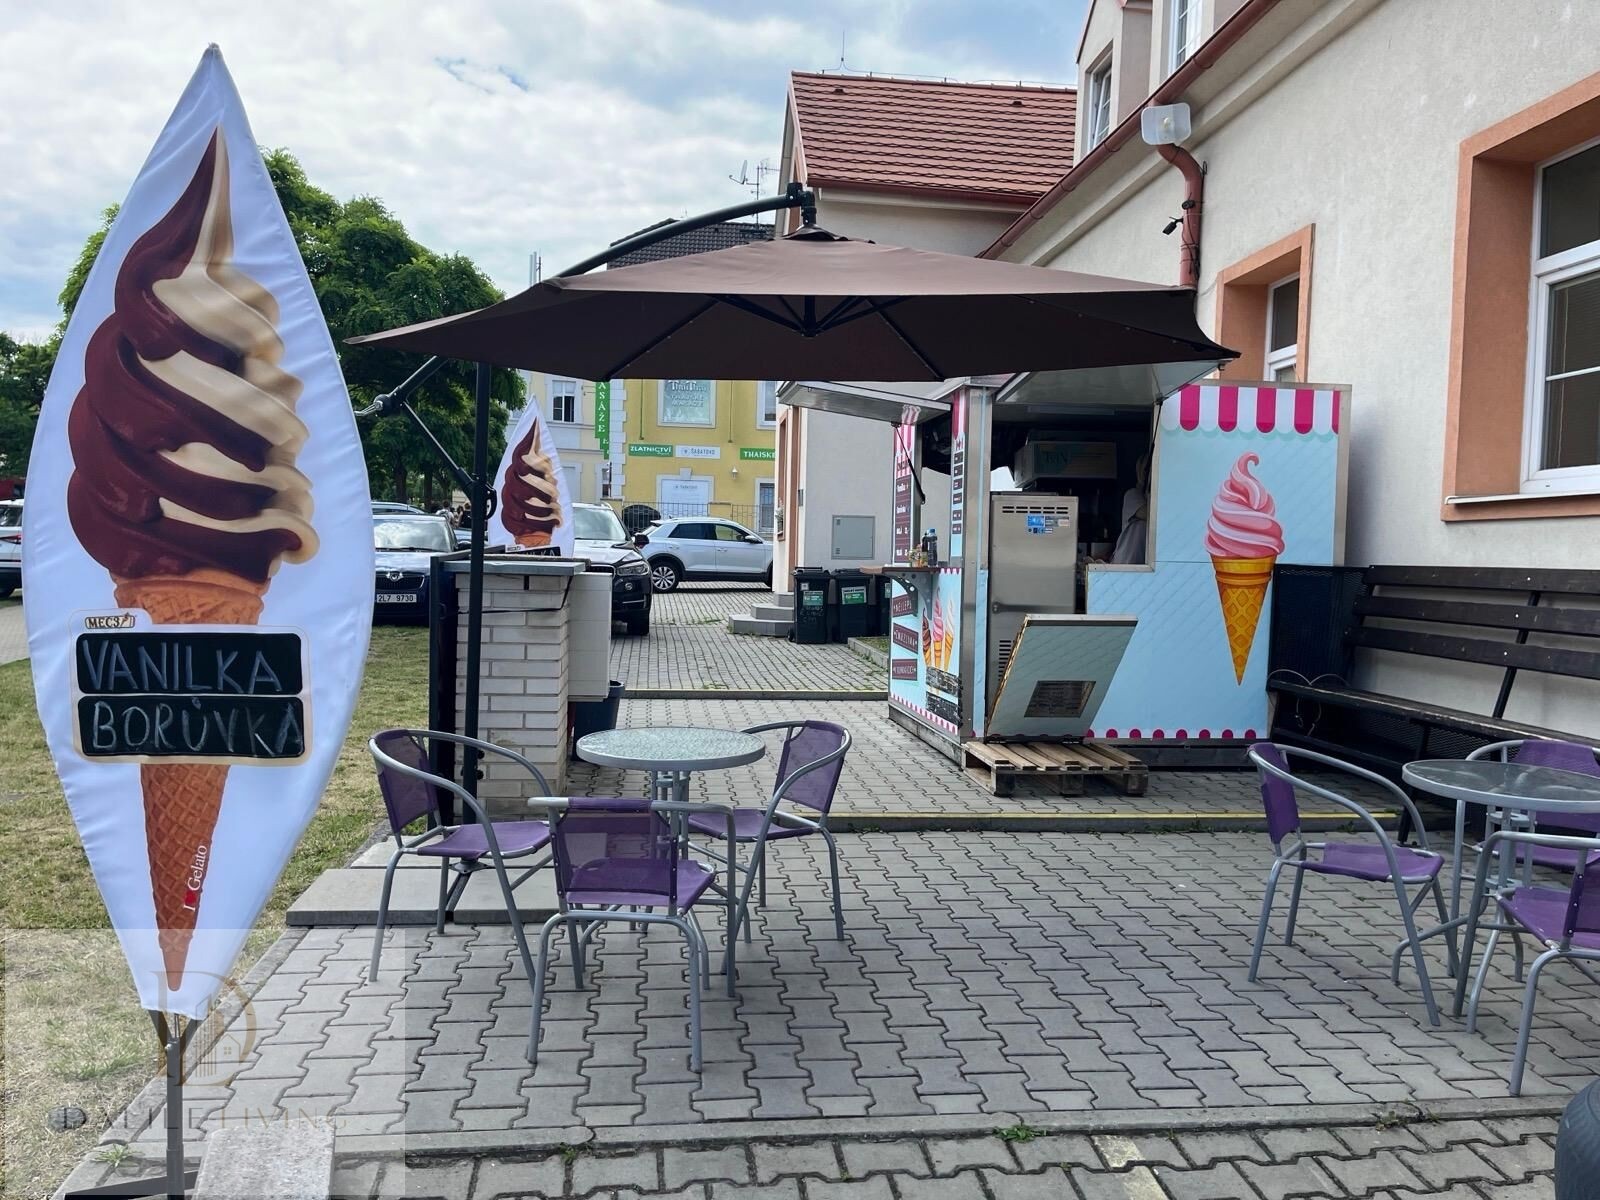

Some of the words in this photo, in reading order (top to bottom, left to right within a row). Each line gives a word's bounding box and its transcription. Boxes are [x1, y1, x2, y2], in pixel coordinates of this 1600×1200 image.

[88, 616, 120, 627] MEC3
[82, 639, 282, 694] VANILKA
[187, 845, 207, 891] Gelato
